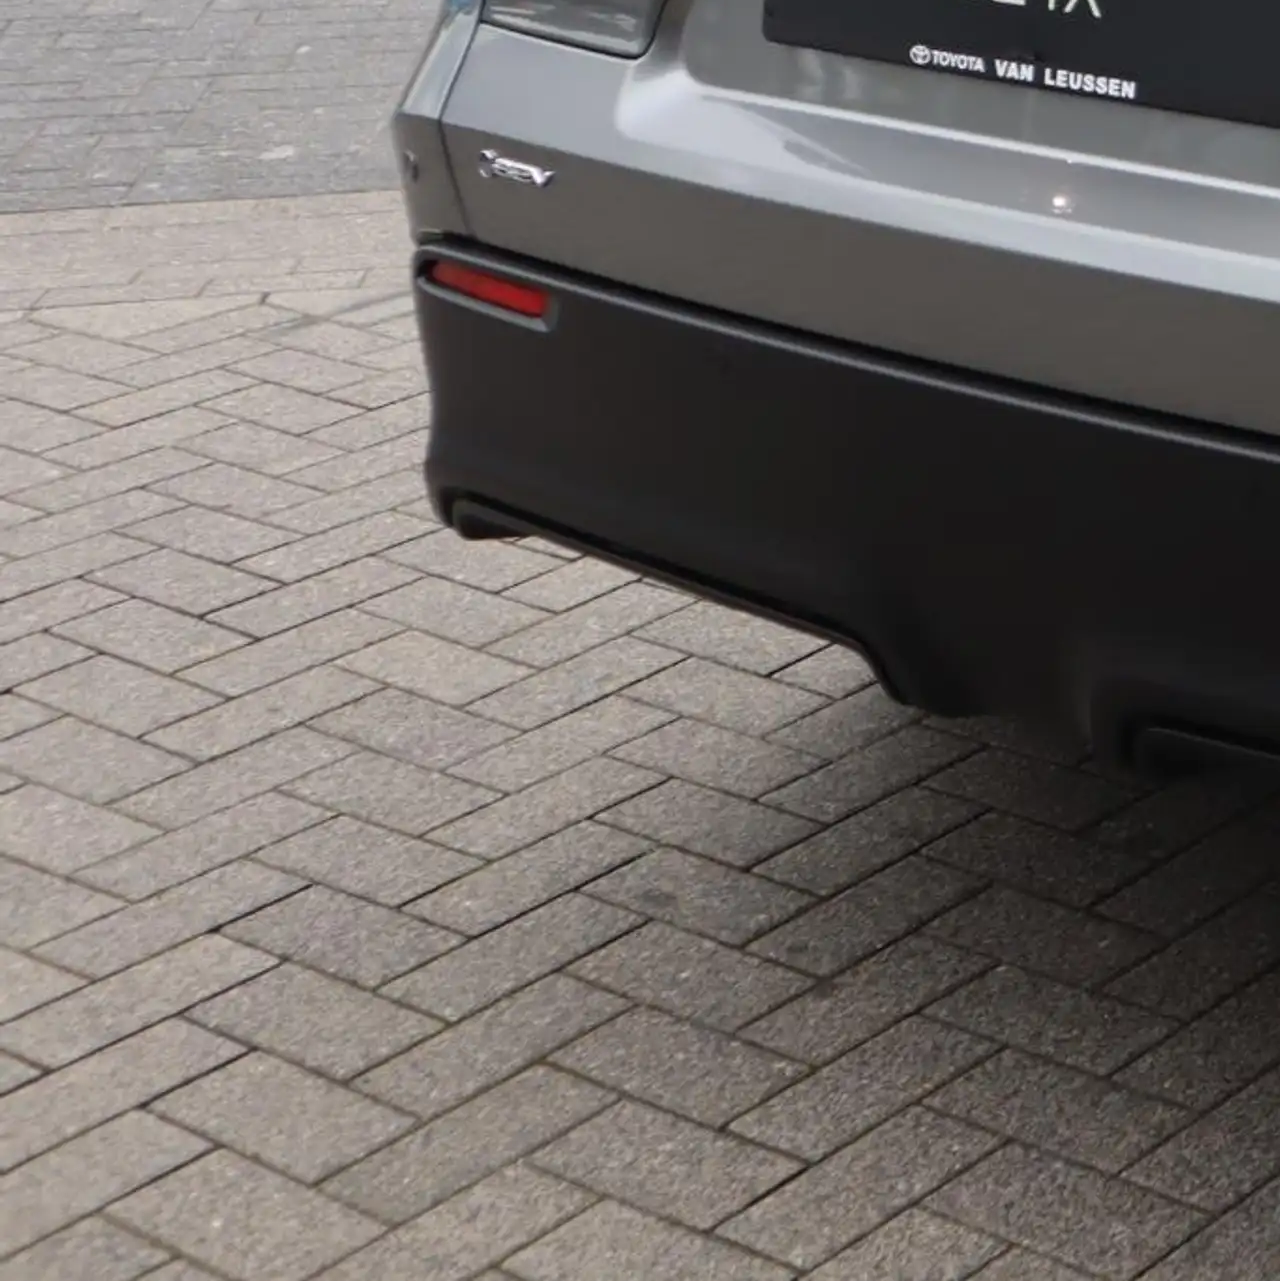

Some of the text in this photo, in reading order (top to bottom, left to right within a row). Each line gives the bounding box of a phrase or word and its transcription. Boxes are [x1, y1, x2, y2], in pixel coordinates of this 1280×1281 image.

[931, 49, 1137, 99] TOYOTA VAN LEUSSEN
